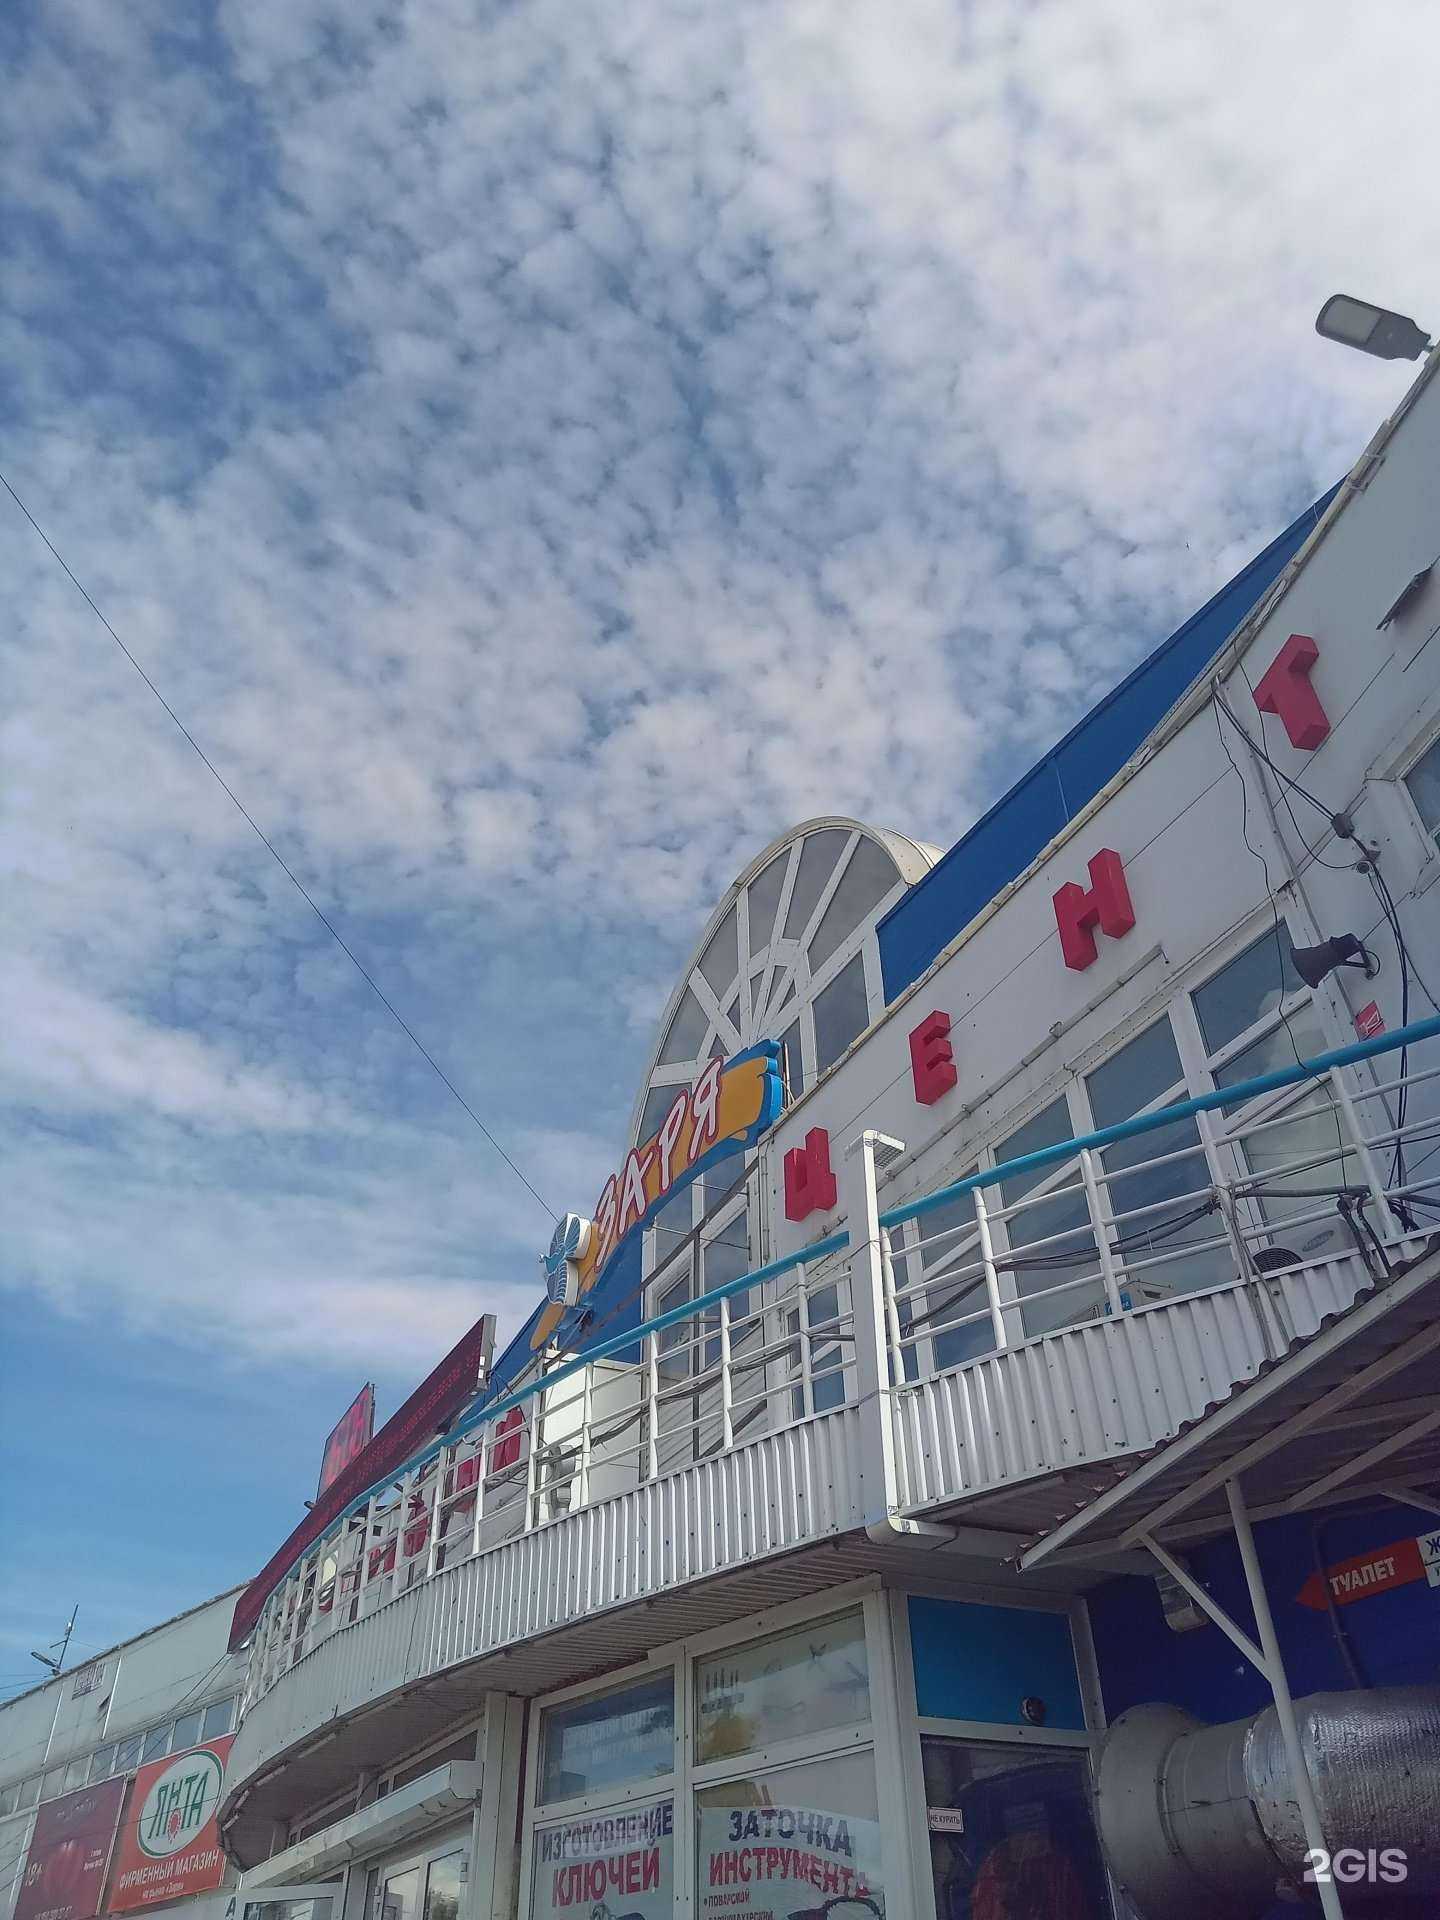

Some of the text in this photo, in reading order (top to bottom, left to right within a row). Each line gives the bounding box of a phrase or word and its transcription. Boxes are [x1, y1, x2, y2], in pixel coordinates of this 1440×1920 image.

[592, 1055, 724, 1272] ЗАРЯ
[1329, 1557, 1396, 1595] ТУАЛЕТ
[542, 1804, 673, 1863] ИЗГОТОВЛЕНИЕ
[727, 1808, 852, 1857] ЗАТОЧКА
[119, 1859, 175, 1889] ФИРМЕННЫЙ
[175, 1849, 220, 1874] МАГАЗИН
[551, 1839, 660, 1907] КЛЮЧЕЙ
